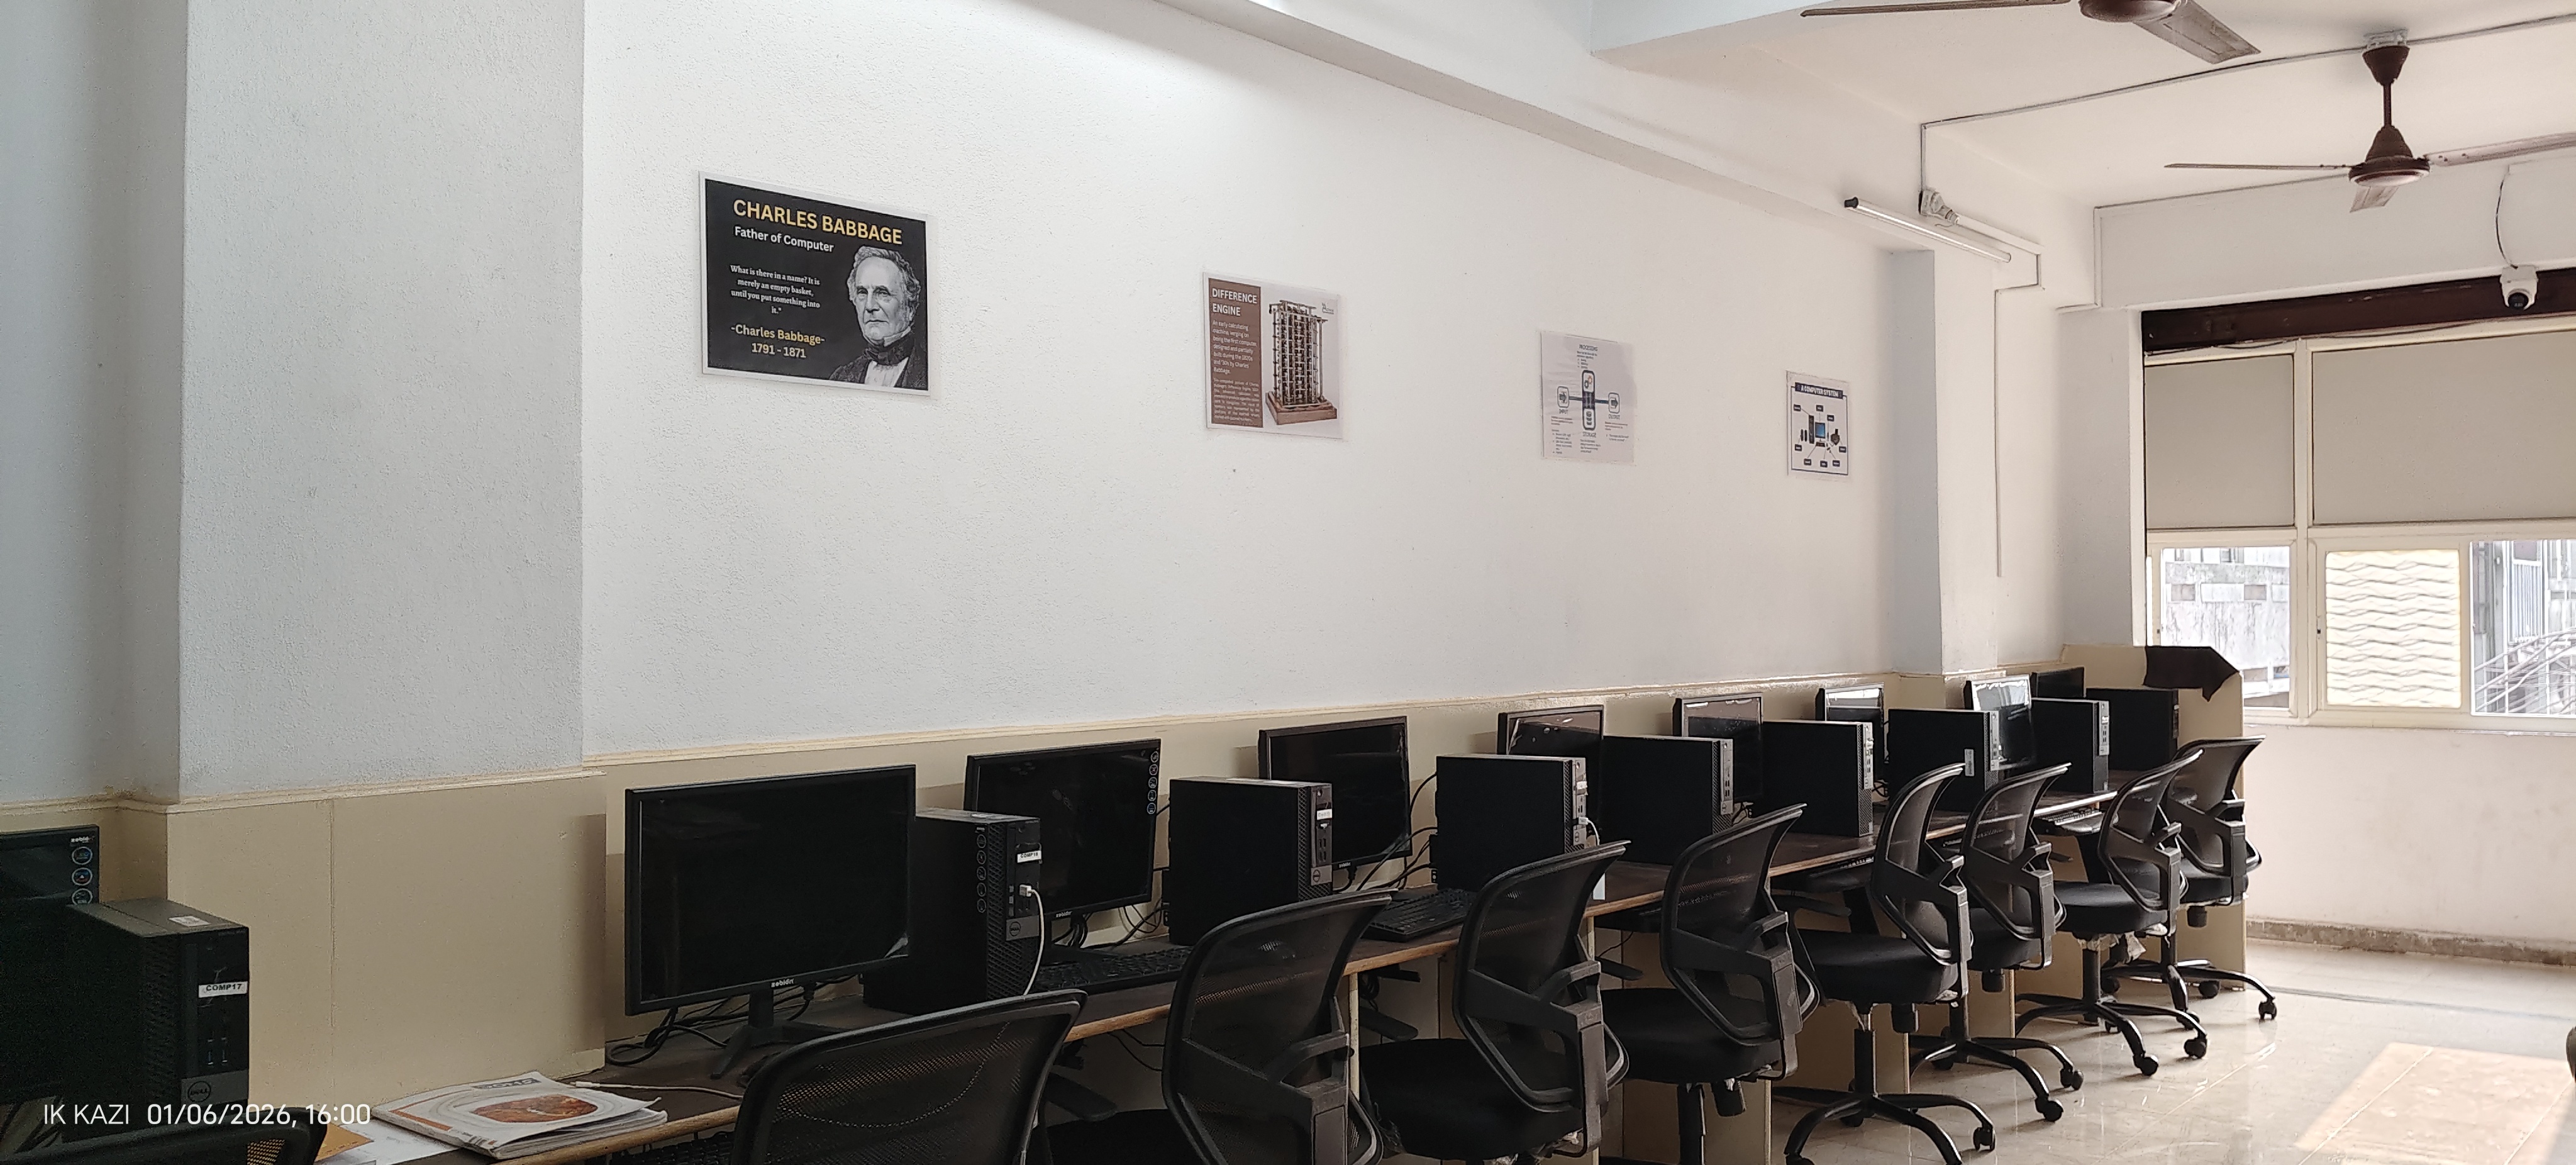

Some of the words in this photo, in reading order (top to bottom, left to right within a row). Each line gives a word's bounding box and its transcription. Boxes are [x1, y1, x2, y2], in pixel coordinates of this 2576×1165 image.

[733, 199, 817, 229] CHARLES
[822, 216, 902, 245] BABBAGE
[735, 226, 768, 242] Father
[770, 233, 782, 243] of
[784, 235, 834, 252] Computer
[730, 265, 749, 274] What
[756, 269, 774, 279] there
[737, 279, 760, 289] merely
[770, 284, 791, 294] empty
[731, 289, 747, 298] until
[773, 296, 807, 308] something
[1212, 287, 1257, 304] DIFFERENCE
[1213, 303, 1241, 316] ENGINE
[731, 325, 775, 338] -Charles
[777, 329, 825, 346] Babbage-
[752, 343, 775, 355] 1791
[784, 347, 807, 359] 1871
